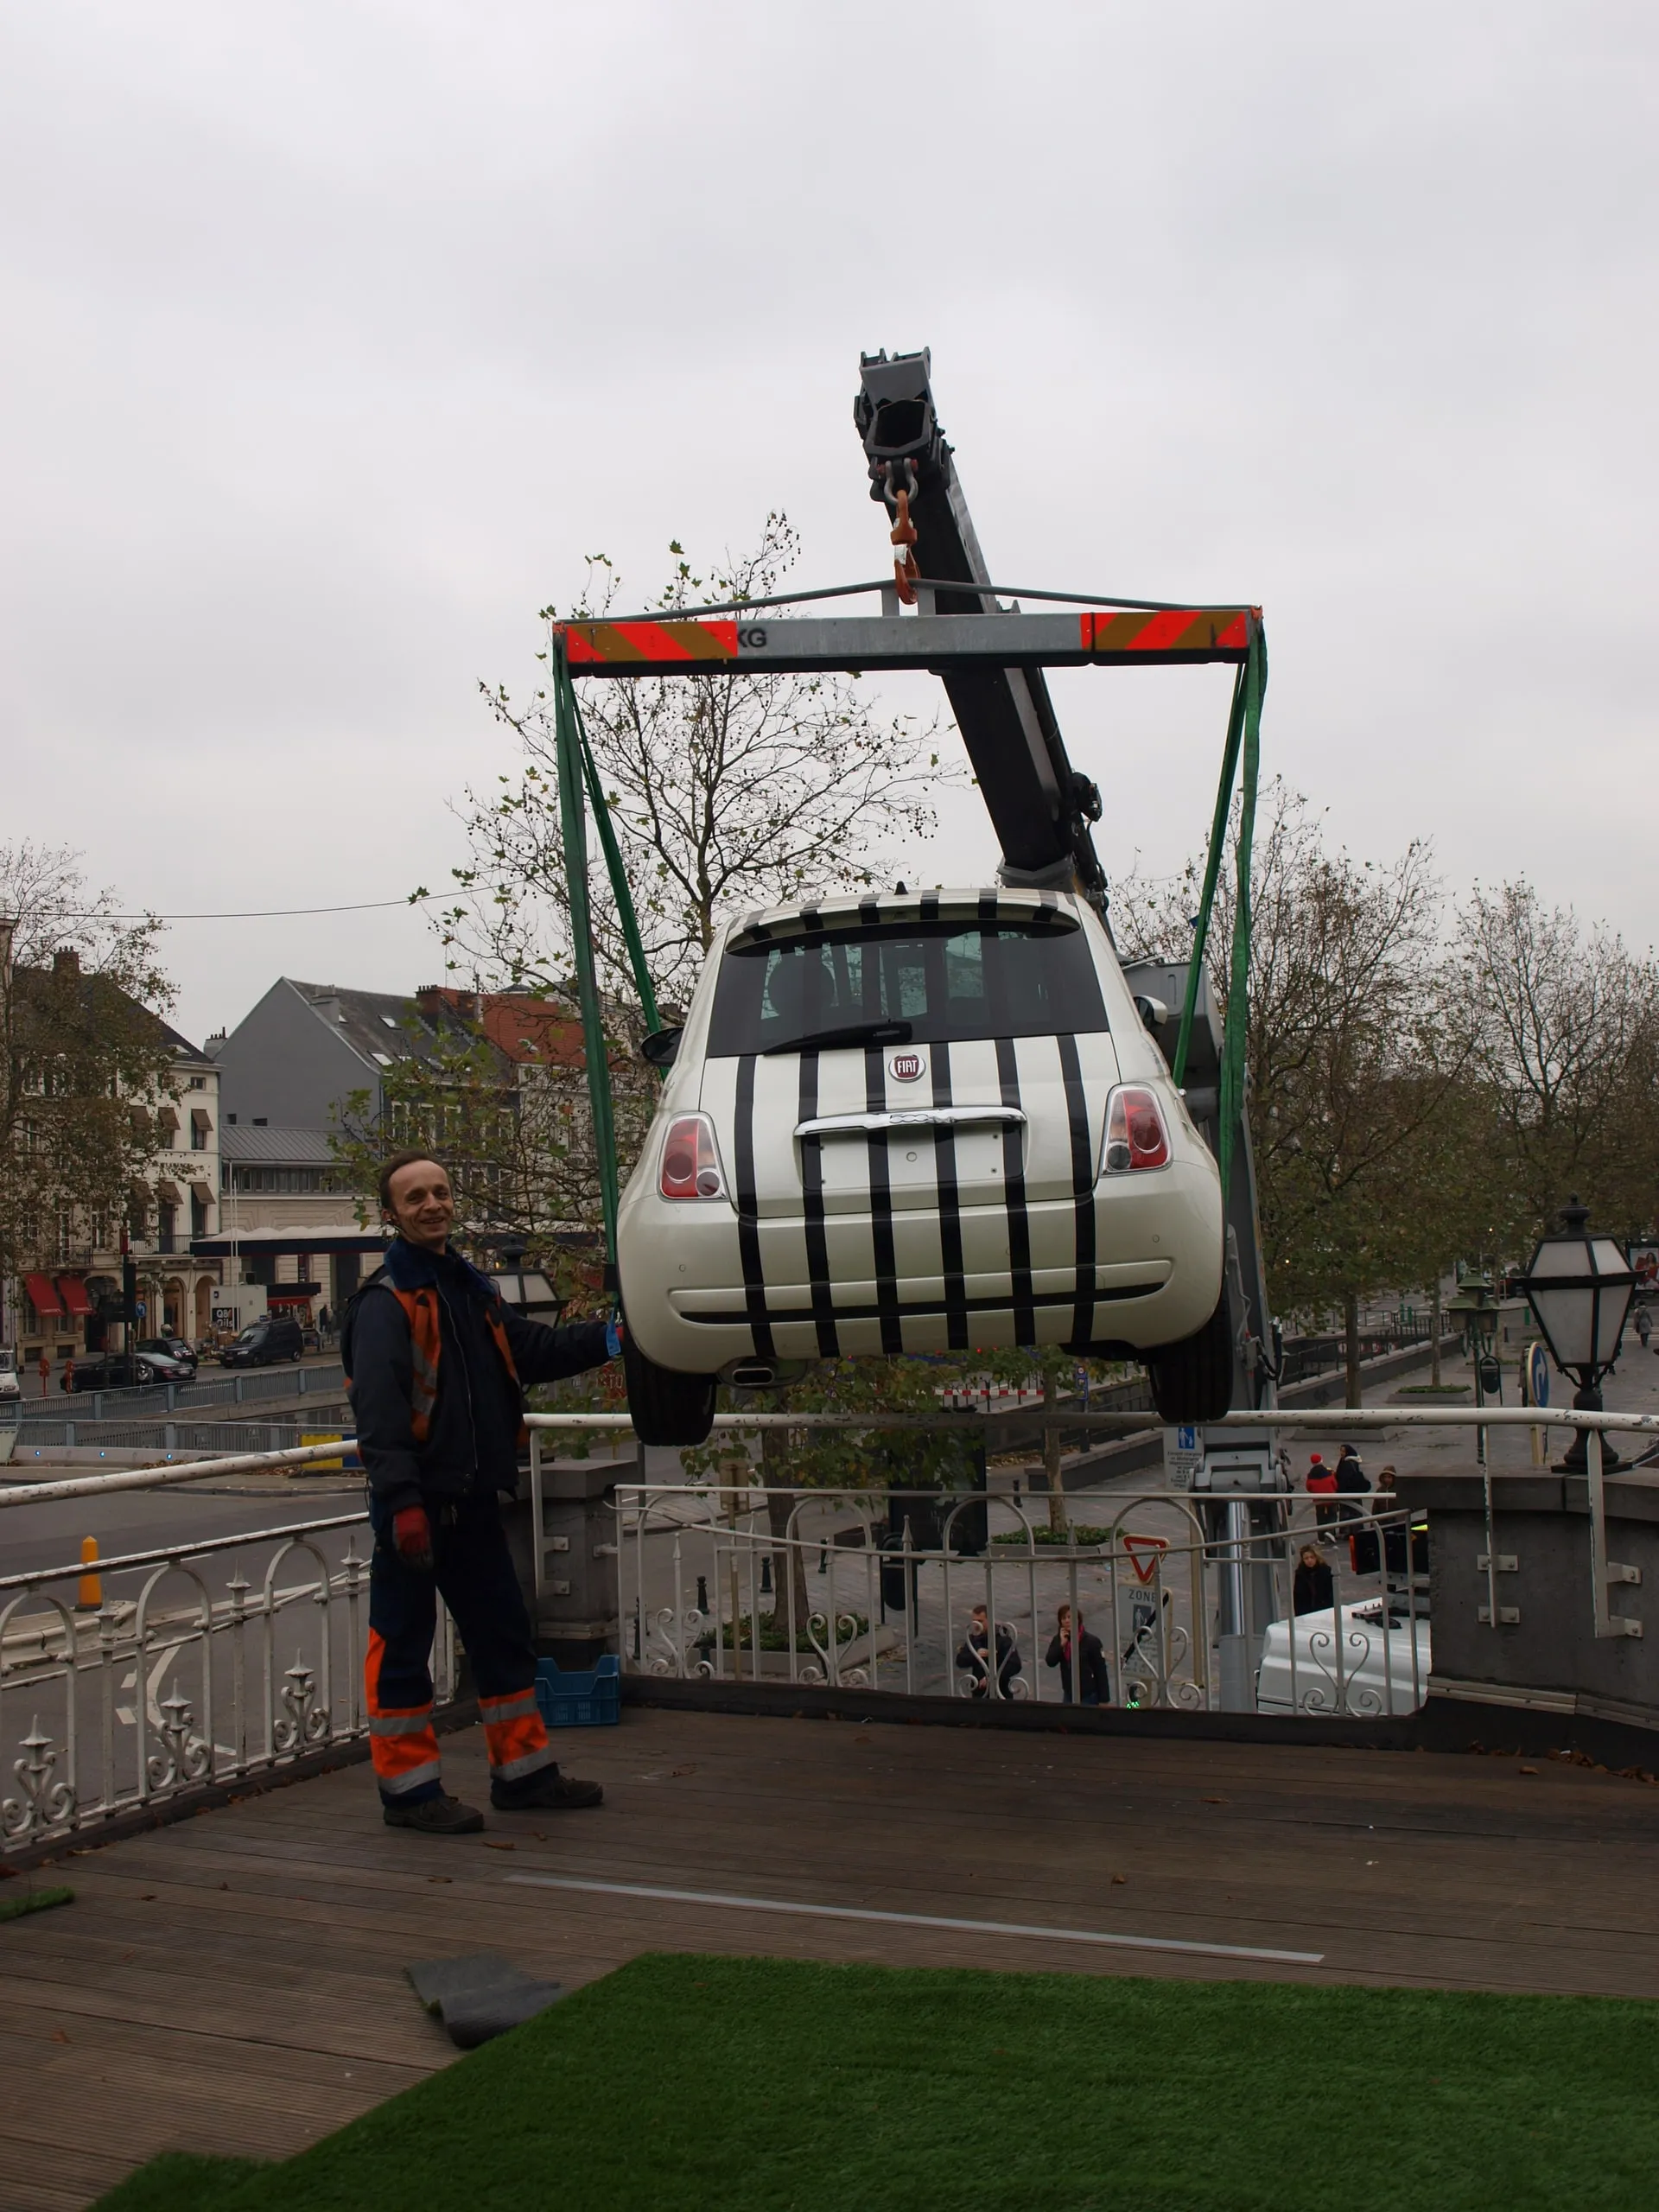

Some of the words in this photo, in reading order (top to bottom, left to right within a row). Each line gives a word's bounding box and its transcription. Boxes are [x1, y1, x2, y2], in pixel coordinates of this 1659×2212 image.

[897, 1059, 918, 1074] FIAT
[889, 1113, 929, 1124] 500
[216, 1309, 228, 1319] Q8
[1128, 1588, 1156, 1604] ZONE
